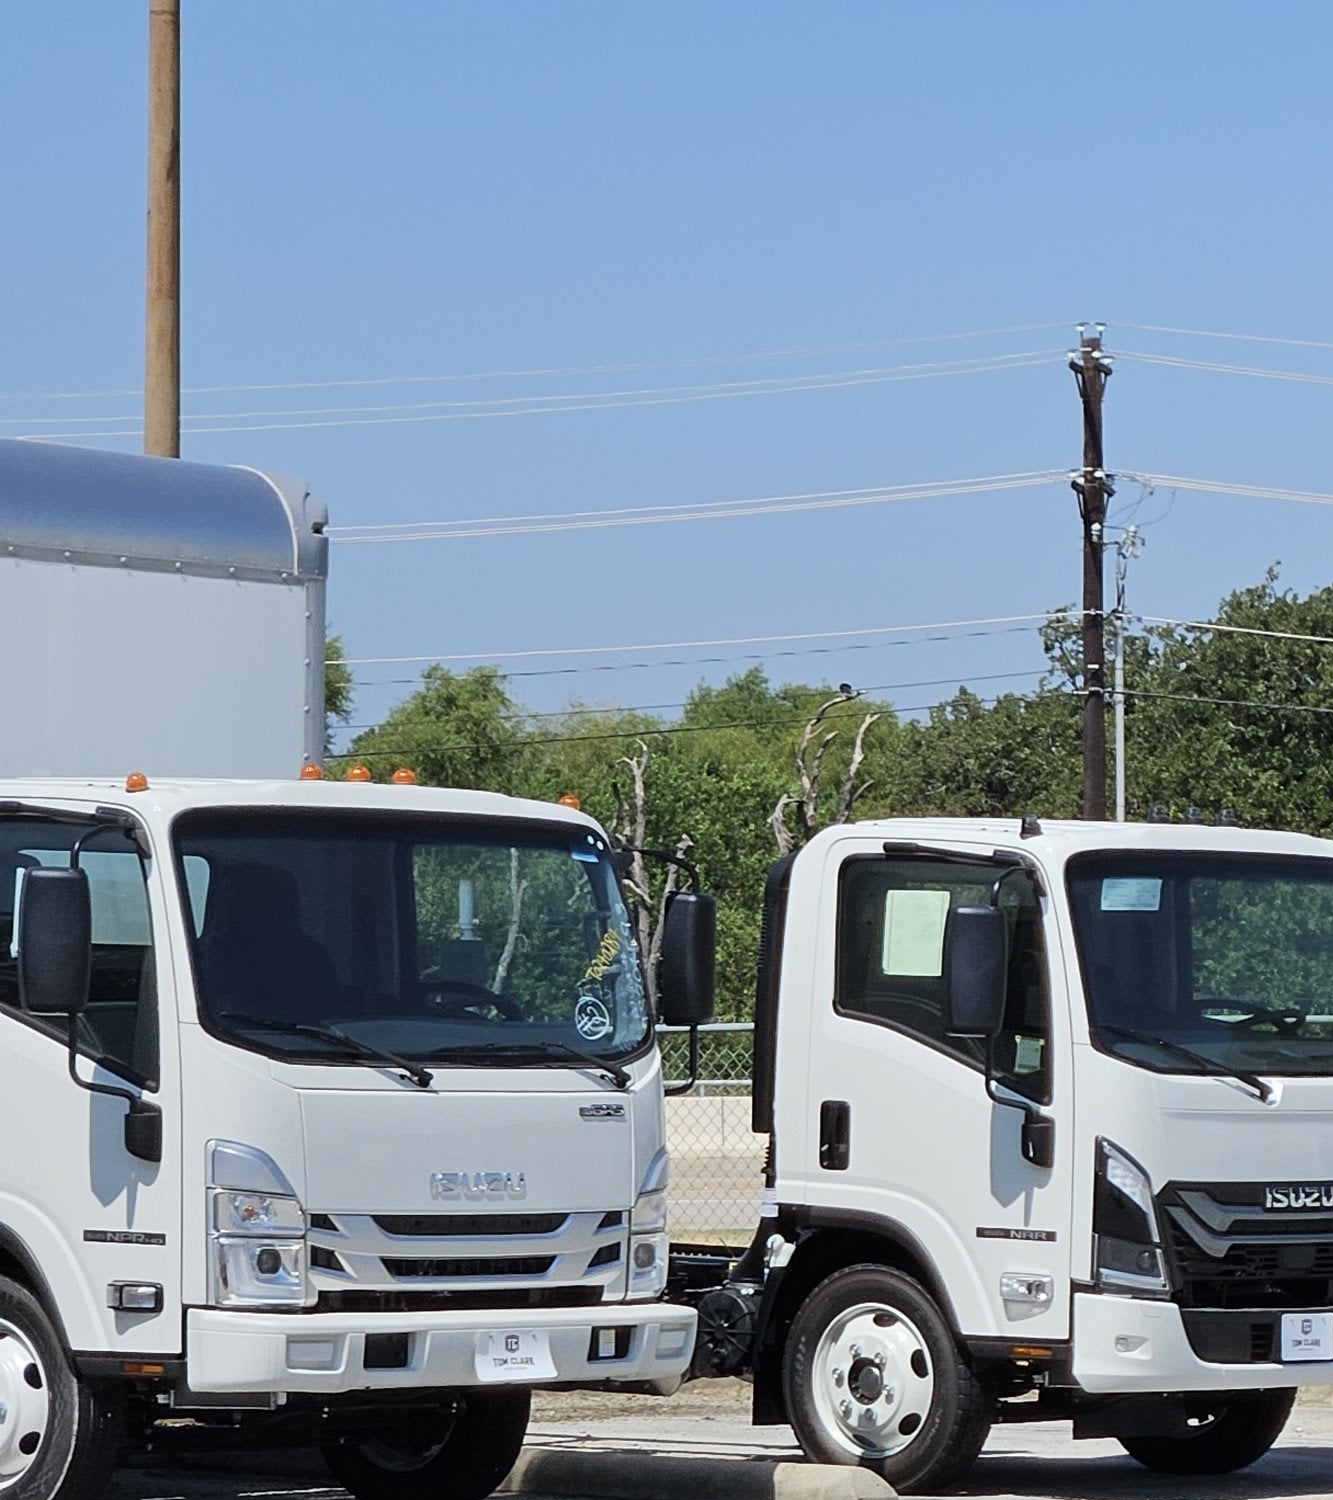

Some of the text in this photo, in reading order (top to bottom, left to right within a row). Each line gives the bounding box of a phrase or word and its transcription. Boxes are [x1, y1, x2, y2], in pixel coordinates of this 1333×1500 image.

[429, 1172, 527, 1198] ISUZU
[106, 1232, 145, 1242] NPR
[1009, 1230, 1047, 1240] NRR
